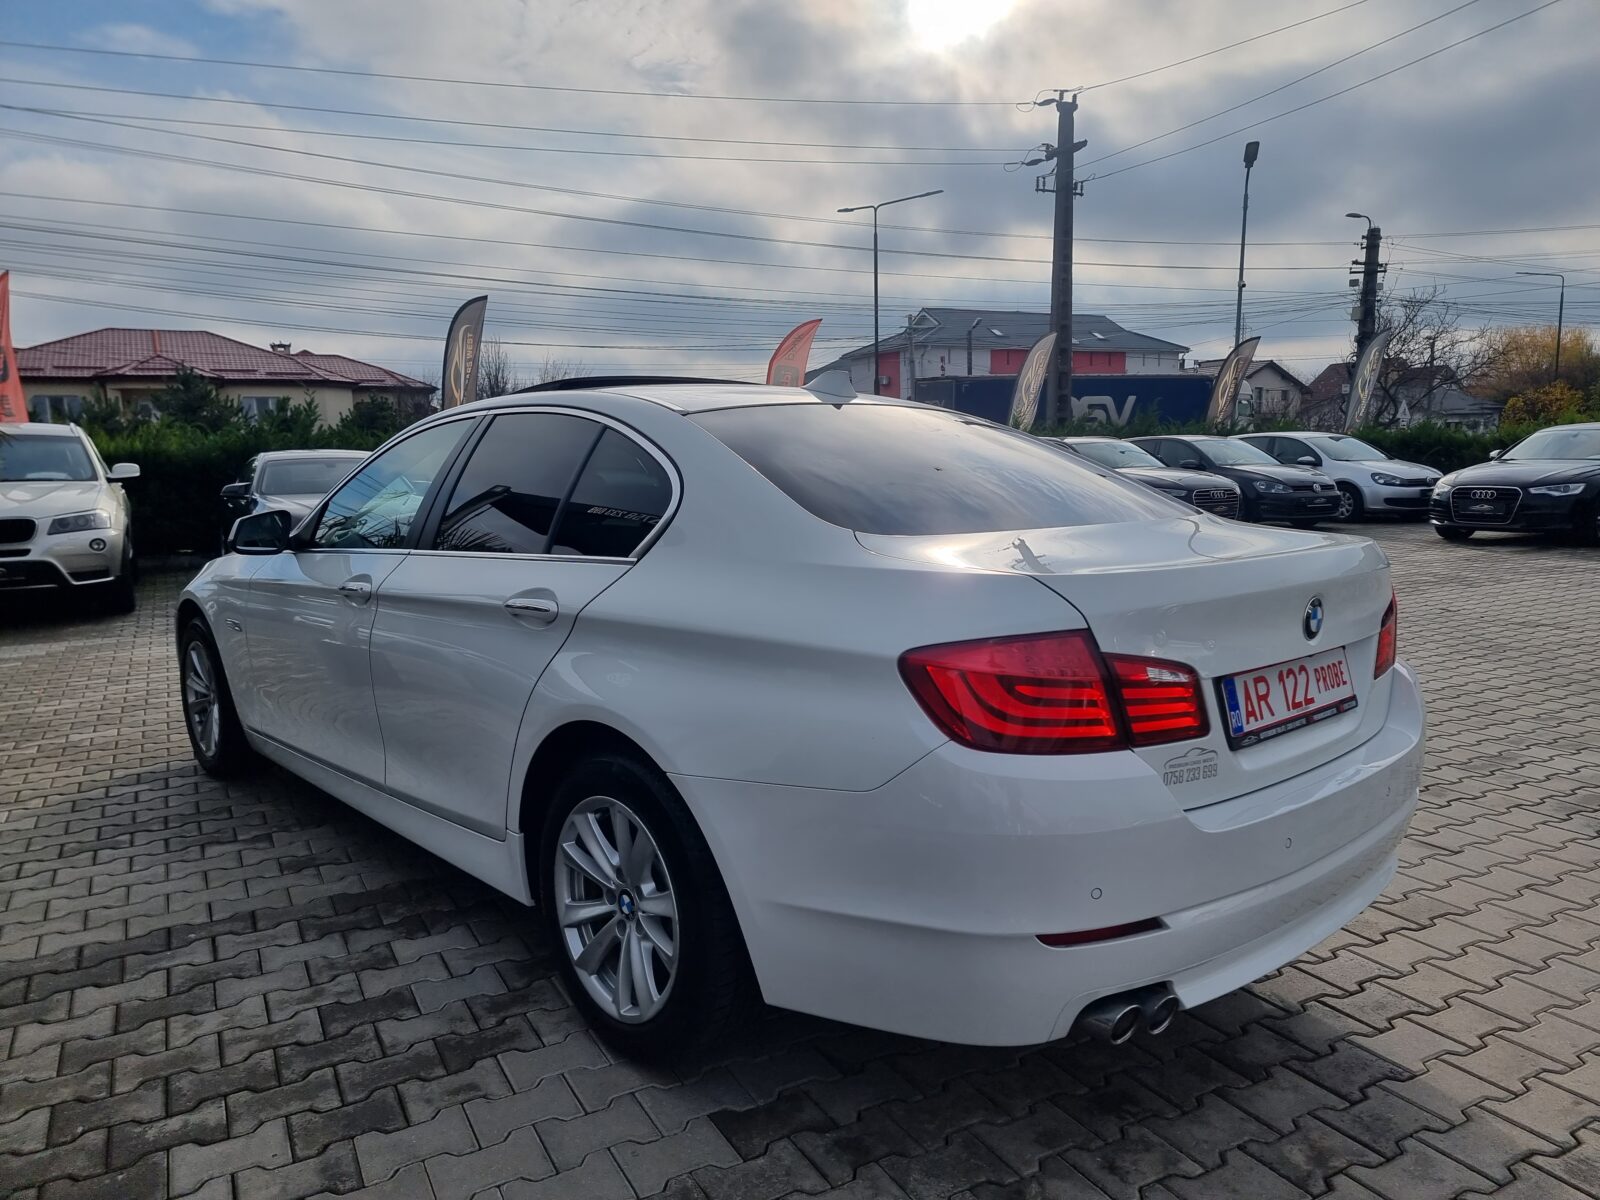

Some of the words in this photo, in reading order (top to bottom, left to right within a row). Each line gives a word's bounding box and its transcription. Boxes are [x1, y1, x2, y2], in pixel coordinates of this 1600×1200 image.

[1243, 674, 1275, 725] AR
[1277, 664, 1315, 711] 122
[1313, 660, 1347, 694] PROBE
[1230, 710, 1242, 729] RO
[1163, 769, 1184, 786] 0758
[1186, 766, 1200, 782] 233
